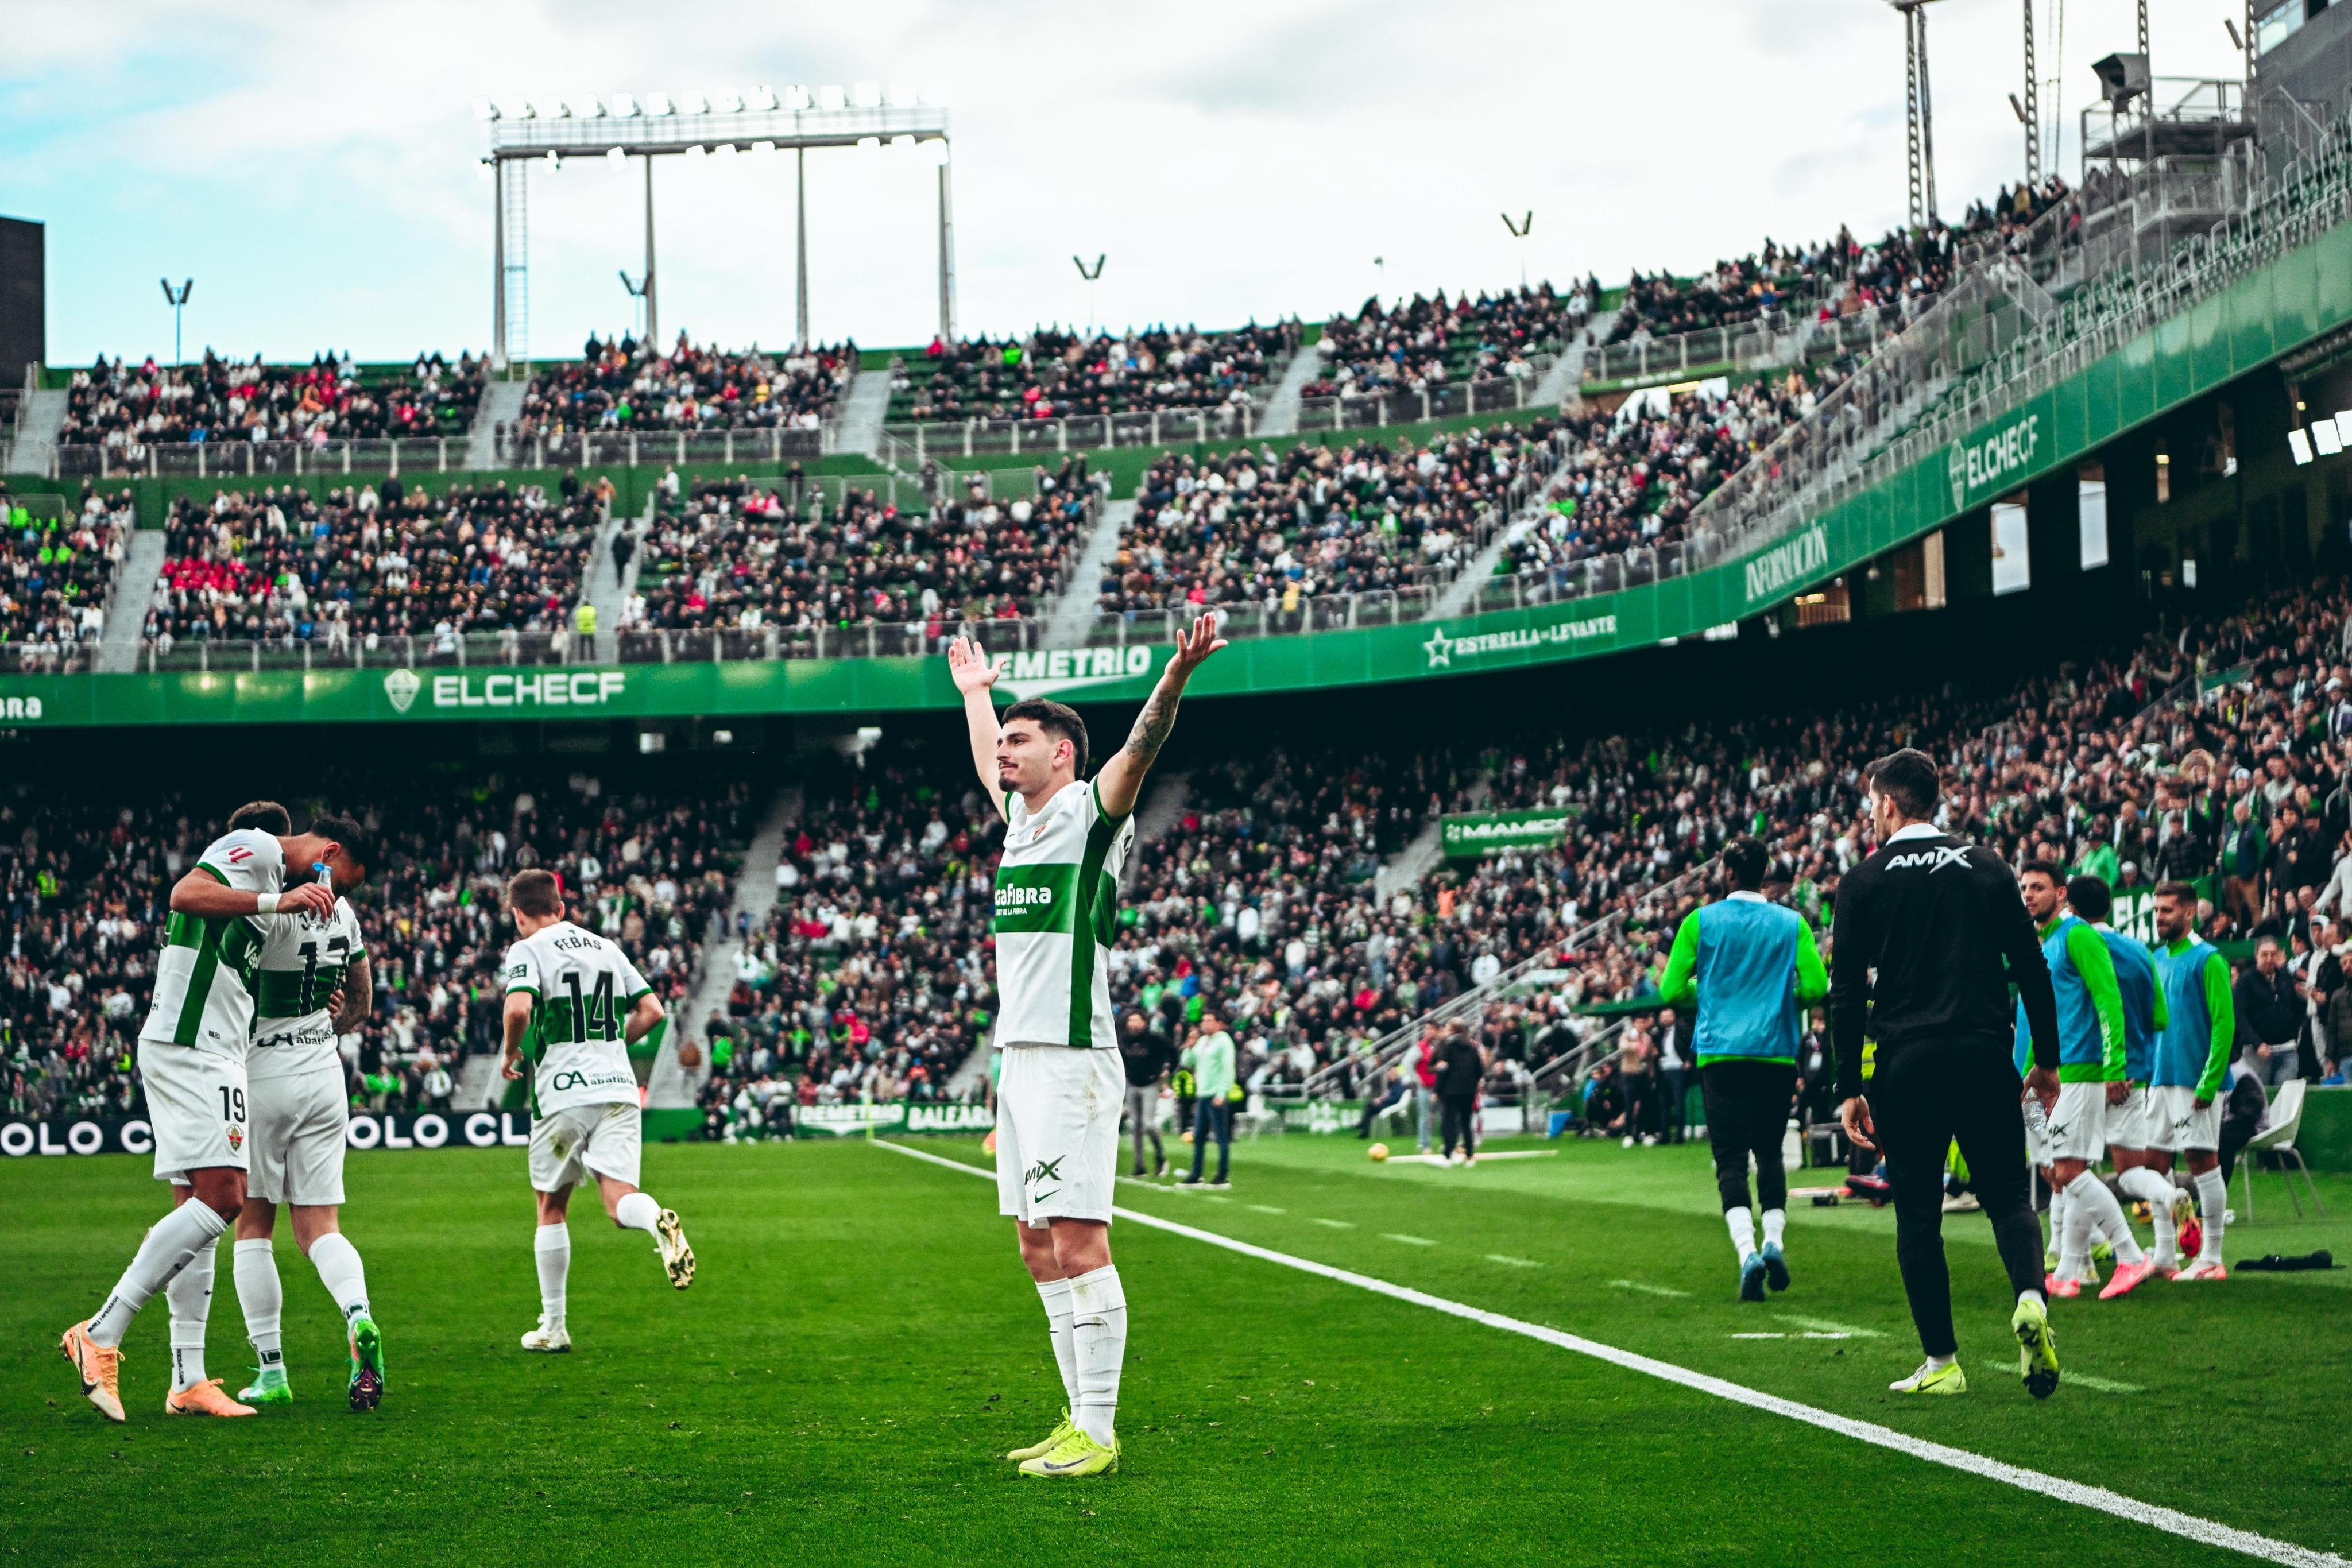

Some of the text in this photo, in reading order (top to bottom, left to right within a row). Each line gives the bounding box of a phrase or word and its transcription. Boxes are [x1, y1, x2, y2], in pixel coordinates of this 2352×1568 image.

[984, 645, 1151, 681] EMETRIO
[433, 672, 625, 707] ELCHECF
[554, 936, 602, 951] FEBAS
[562, 970, 620, 1044] 14
[218, 1085, 246, 1123] 19
